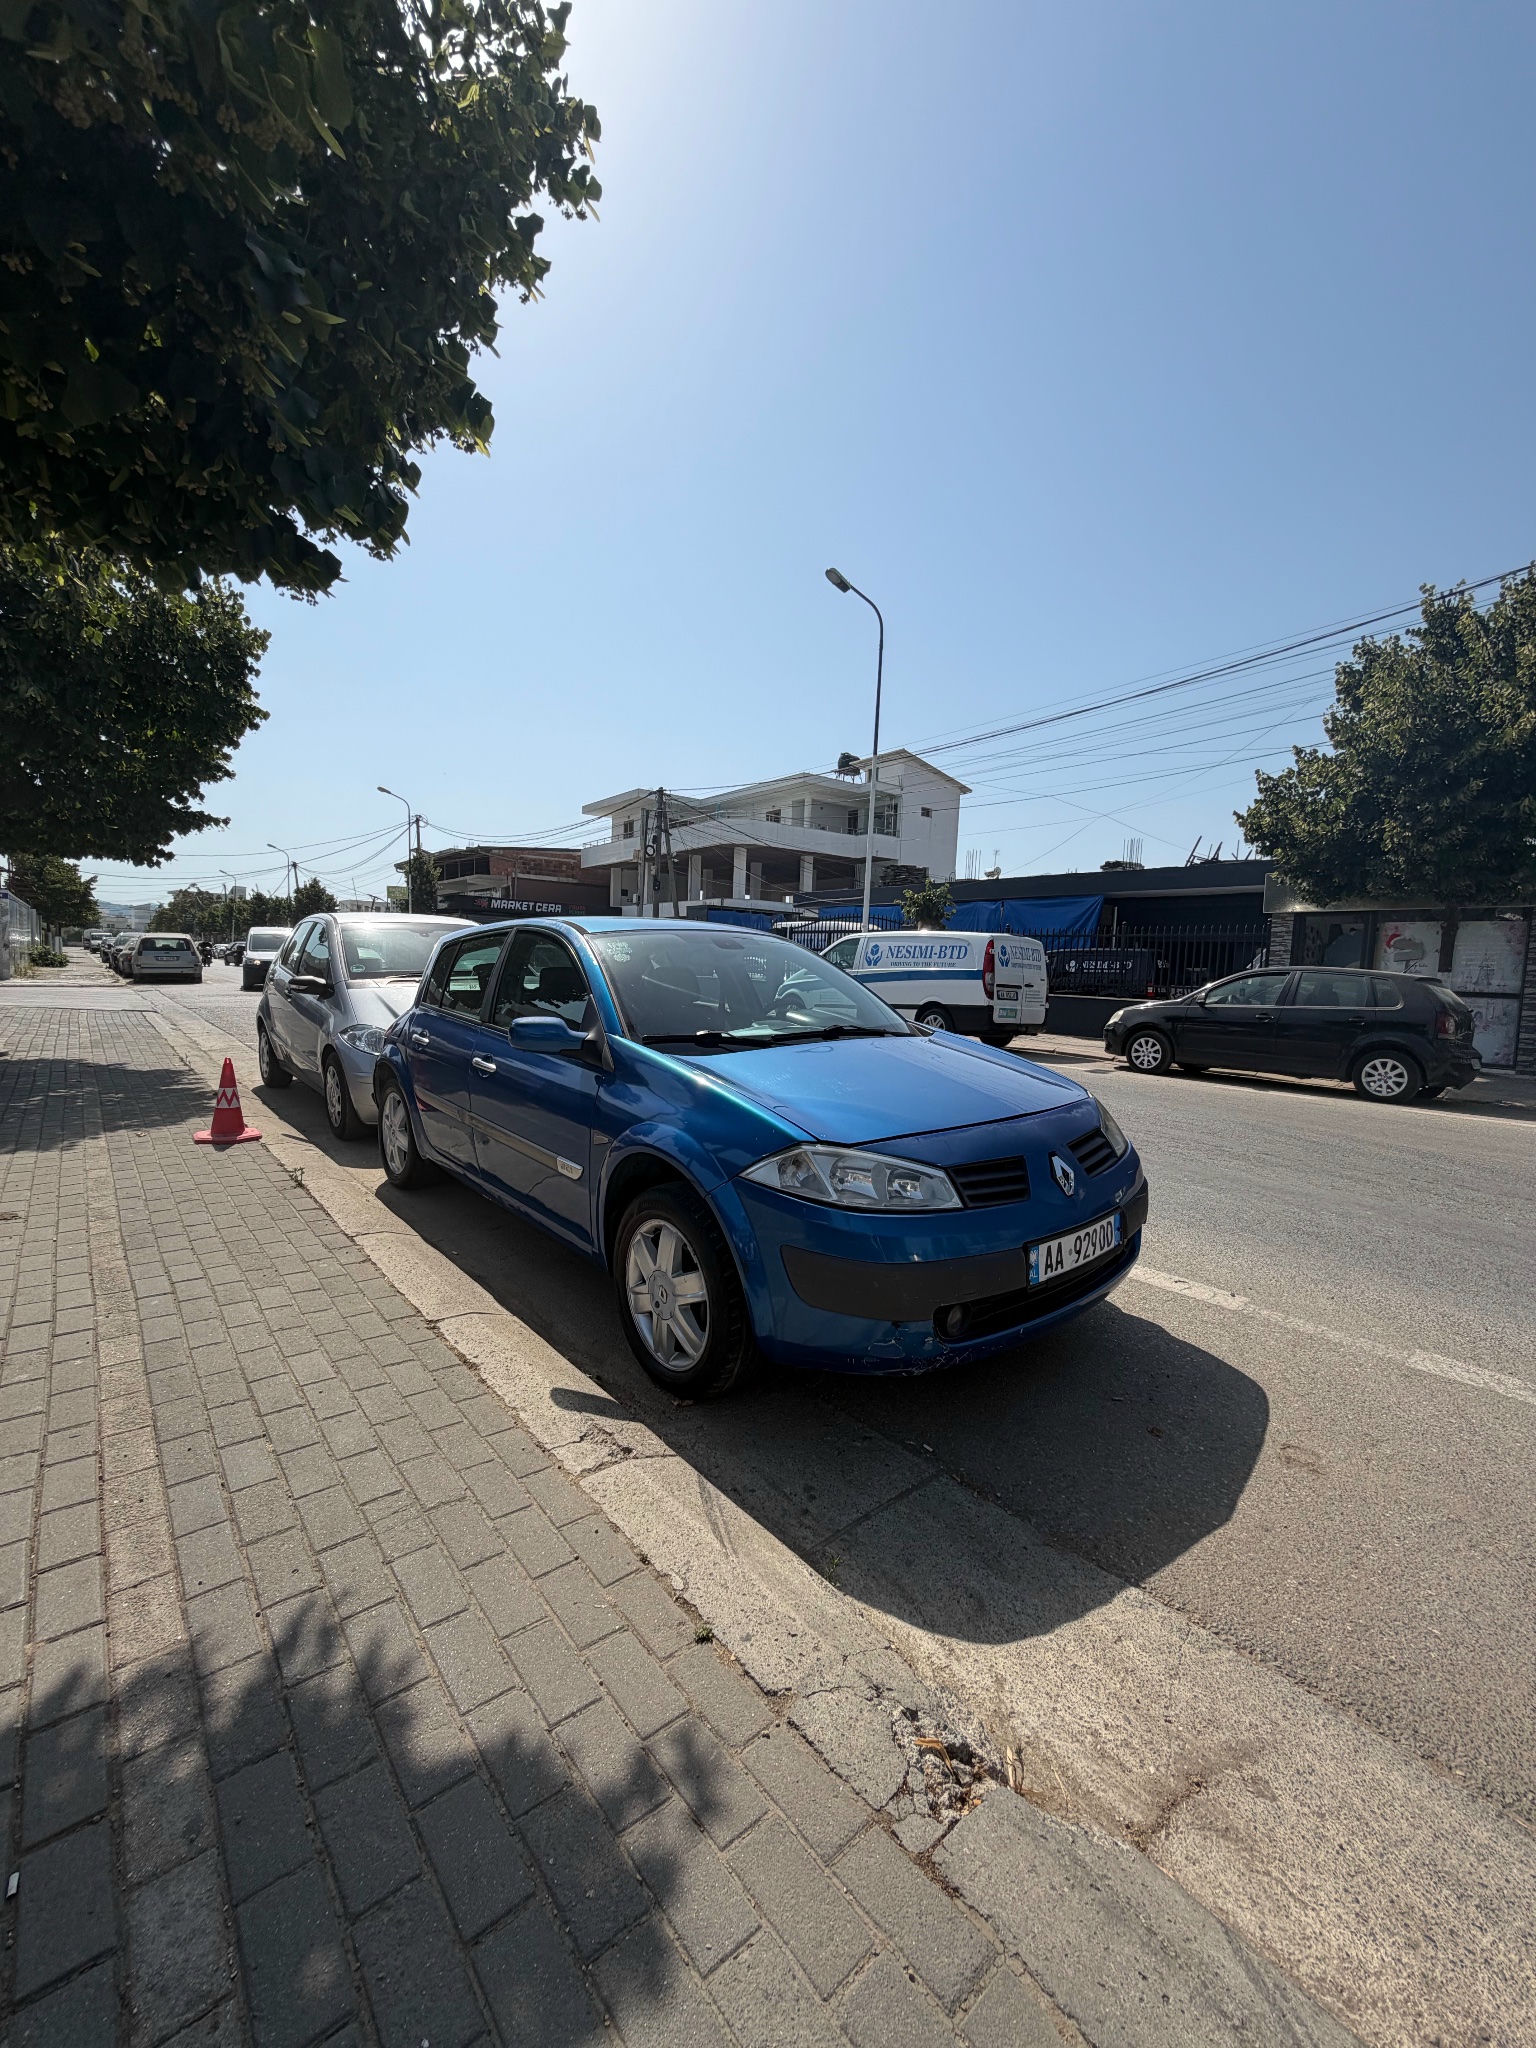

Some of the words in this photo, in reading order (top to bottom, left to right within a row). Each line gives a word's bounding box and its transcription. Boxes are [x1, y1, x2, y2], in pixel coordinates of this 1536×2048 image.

[490, 899, 533, 911] MARKET
[535, 902, 562, 913] CERA
[886, 945, 968, 960] NESIMI-BTD
[1044, 1241, 1064, 1276] AA
